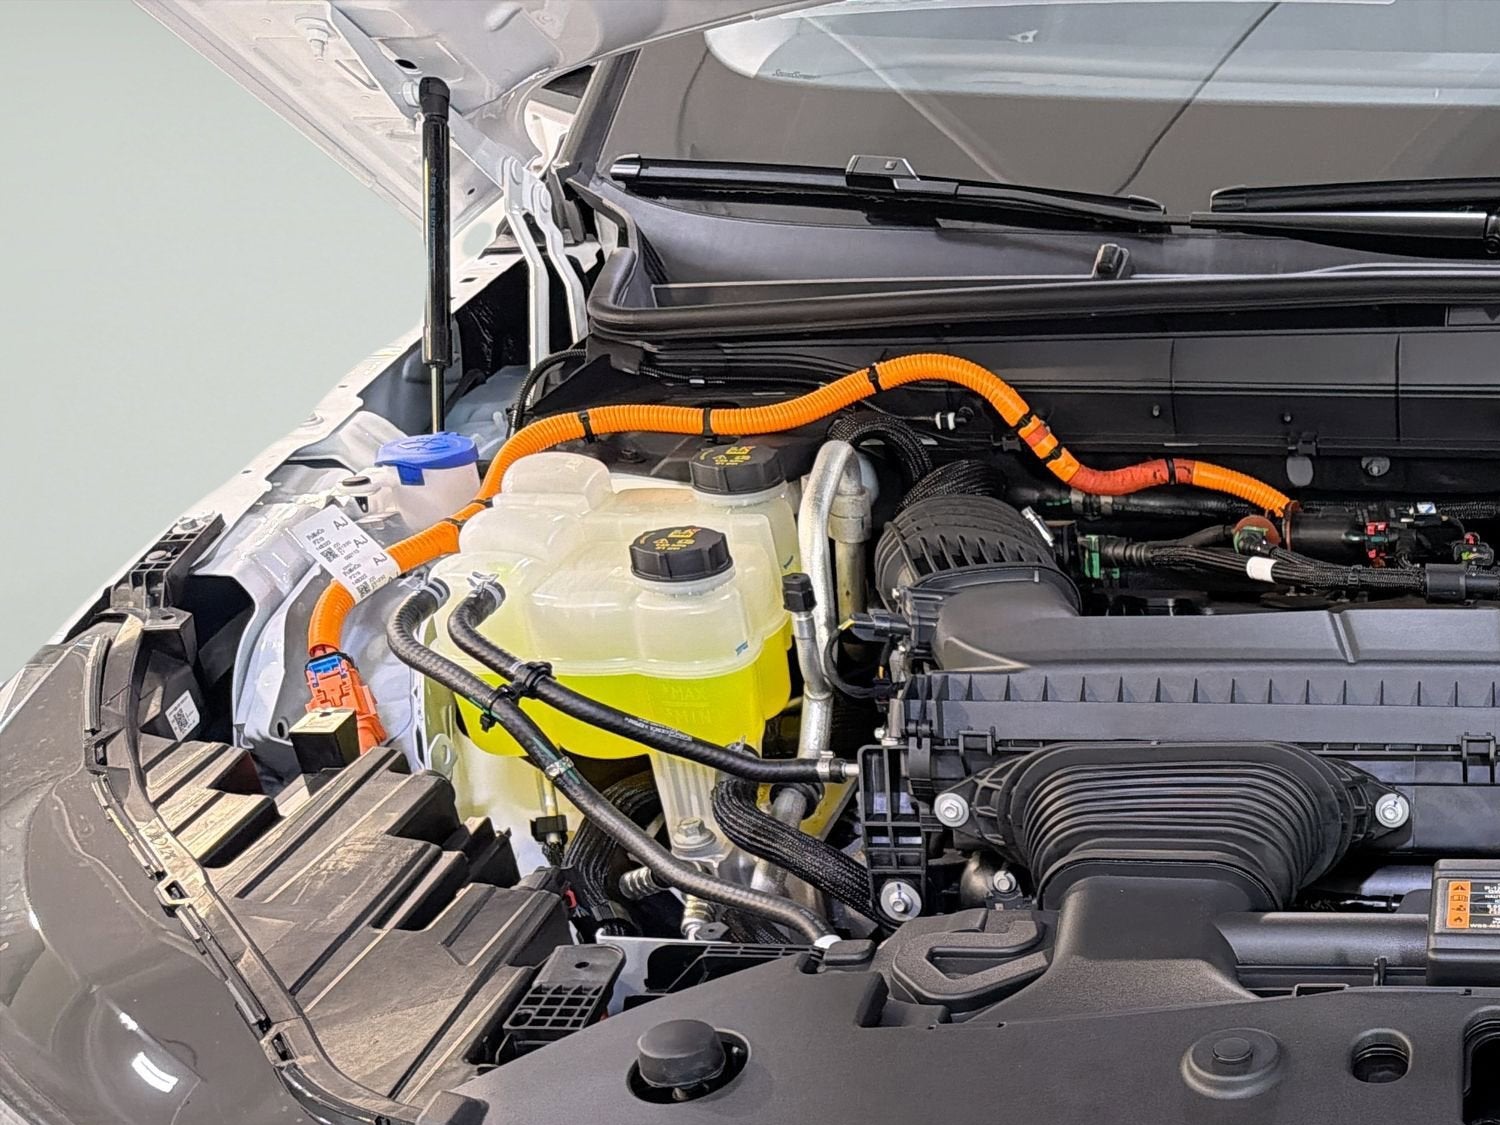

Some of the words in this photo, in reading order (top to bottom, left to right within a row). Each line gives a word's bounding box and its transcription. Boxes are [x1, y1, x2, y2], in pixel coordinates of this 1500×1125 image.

[333, 516, 349, 531] AJ
[353, 534, 369, 549] AJ
[372, 552, 388, 567] AJ
